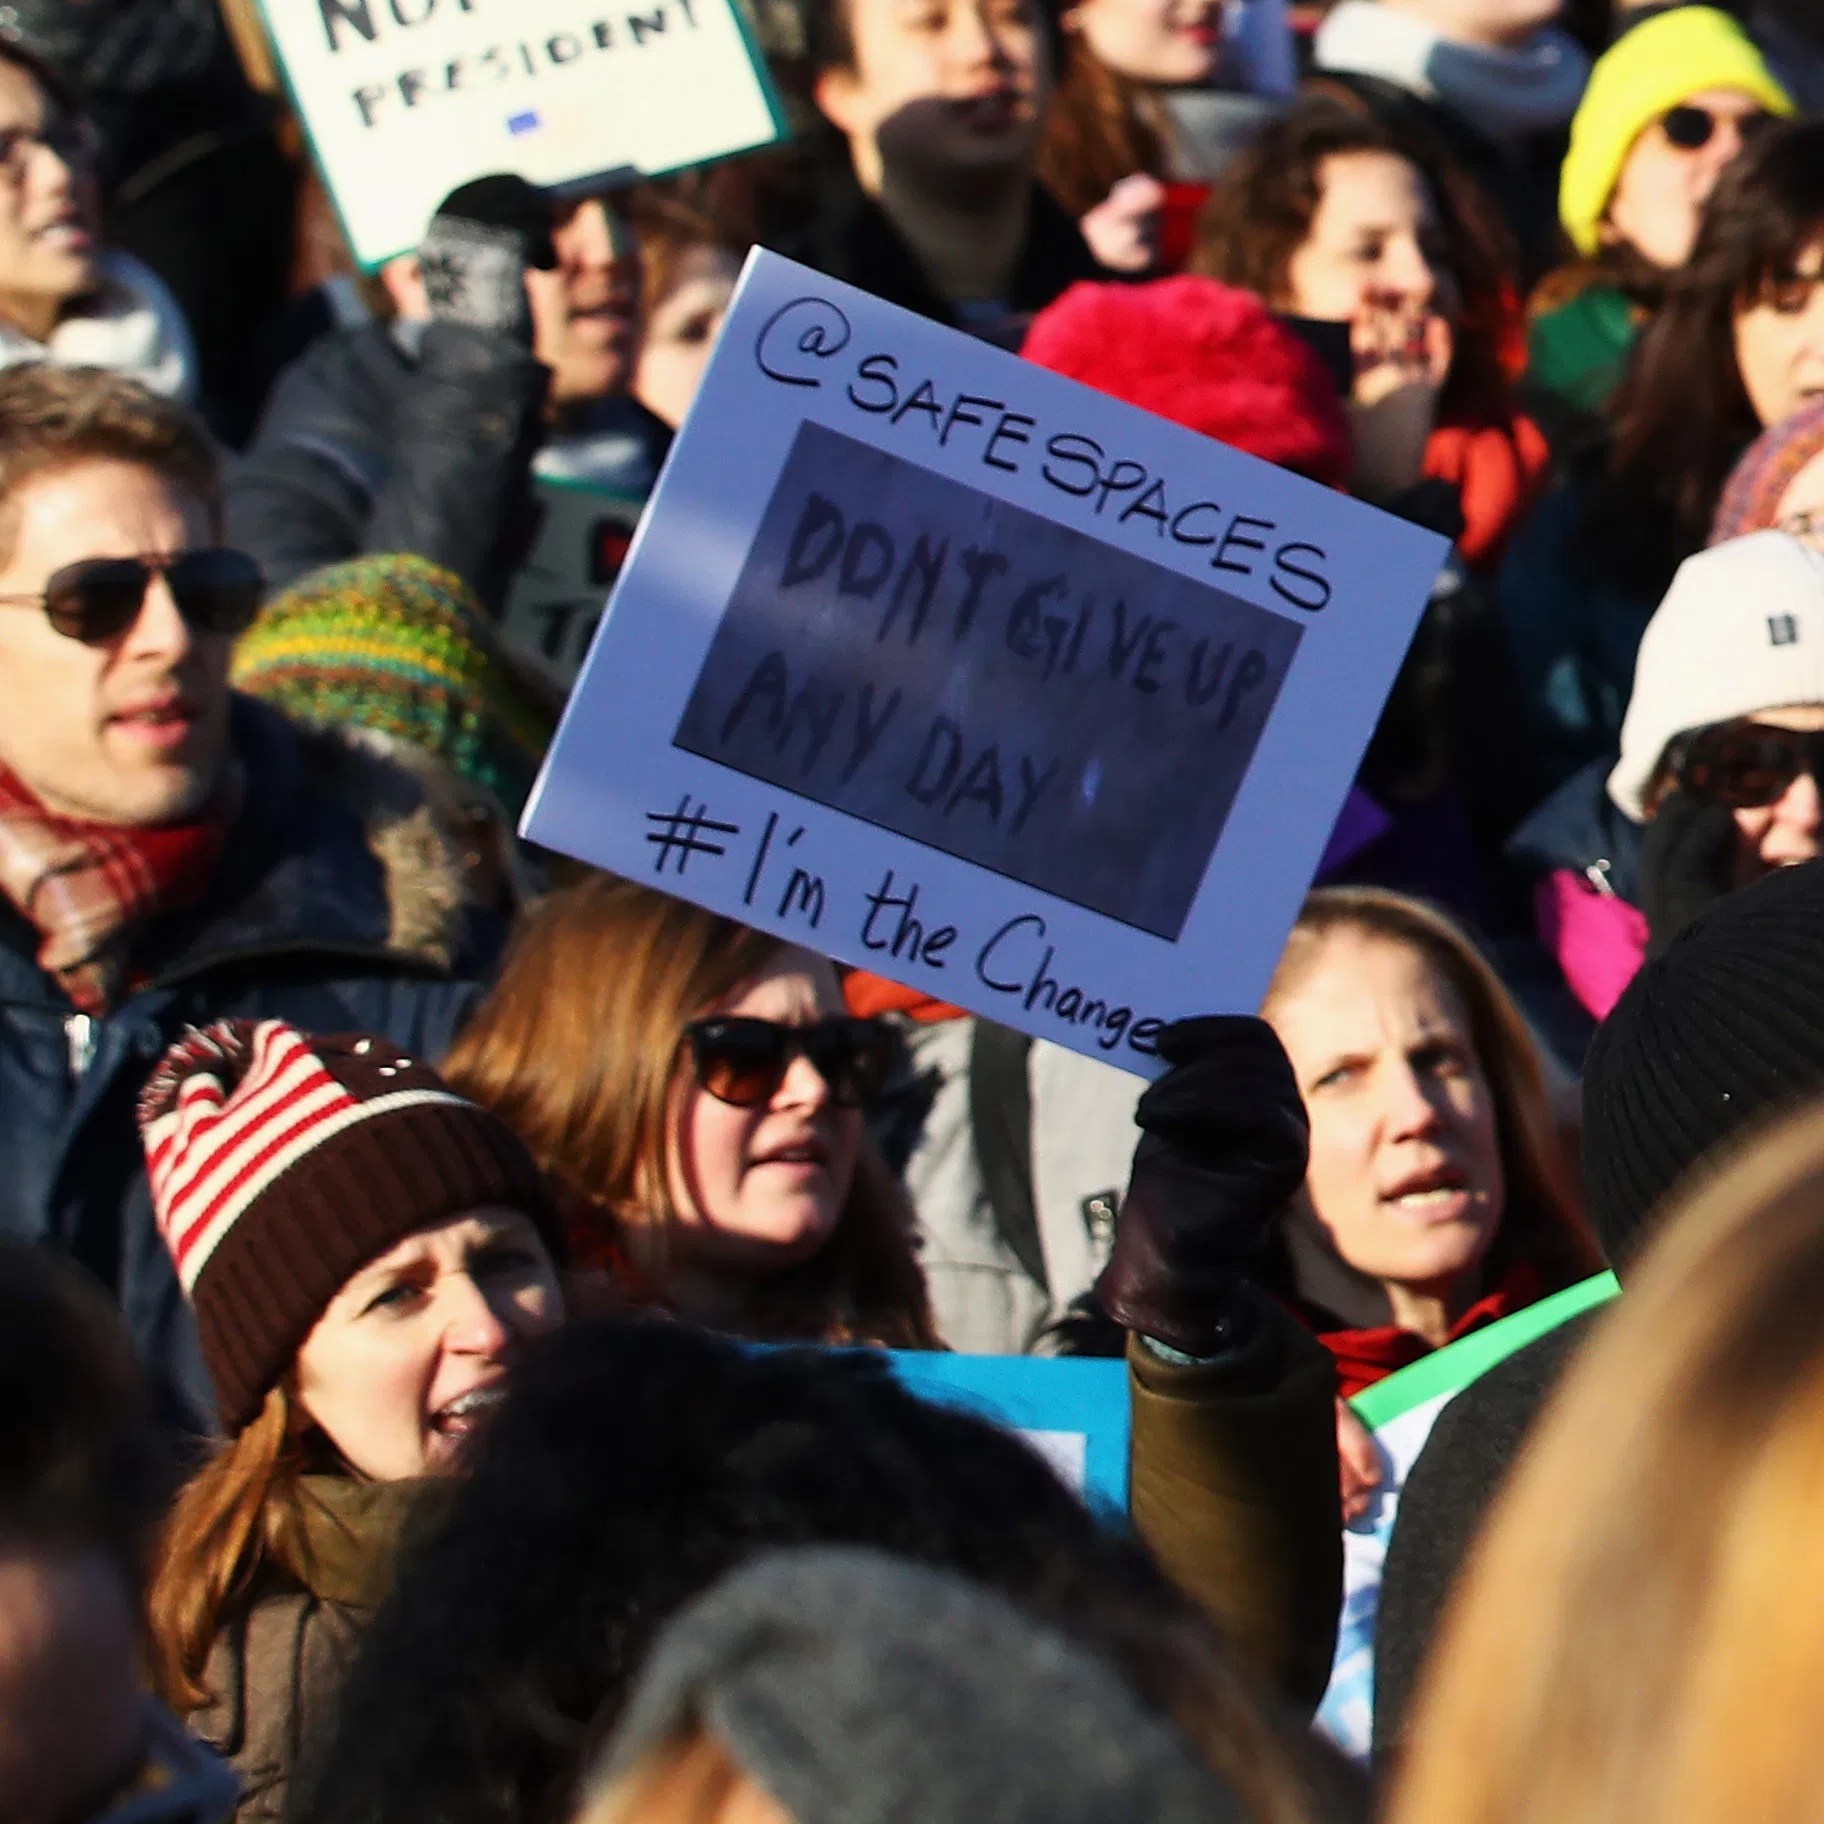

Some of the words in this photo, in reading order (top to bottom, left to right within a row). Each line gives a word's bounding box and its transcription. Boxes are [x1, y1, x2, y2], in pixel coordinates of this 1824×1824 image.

[721, 649, 901, 786] ANY
[904, 713, 1061, 838] DAY
[1006, 572, 1182, 695] GIVE
[1182, 634, 1268, 732] UP
[859, 868, 960, 970] the
[974, 913, 1168, 1057] Change
